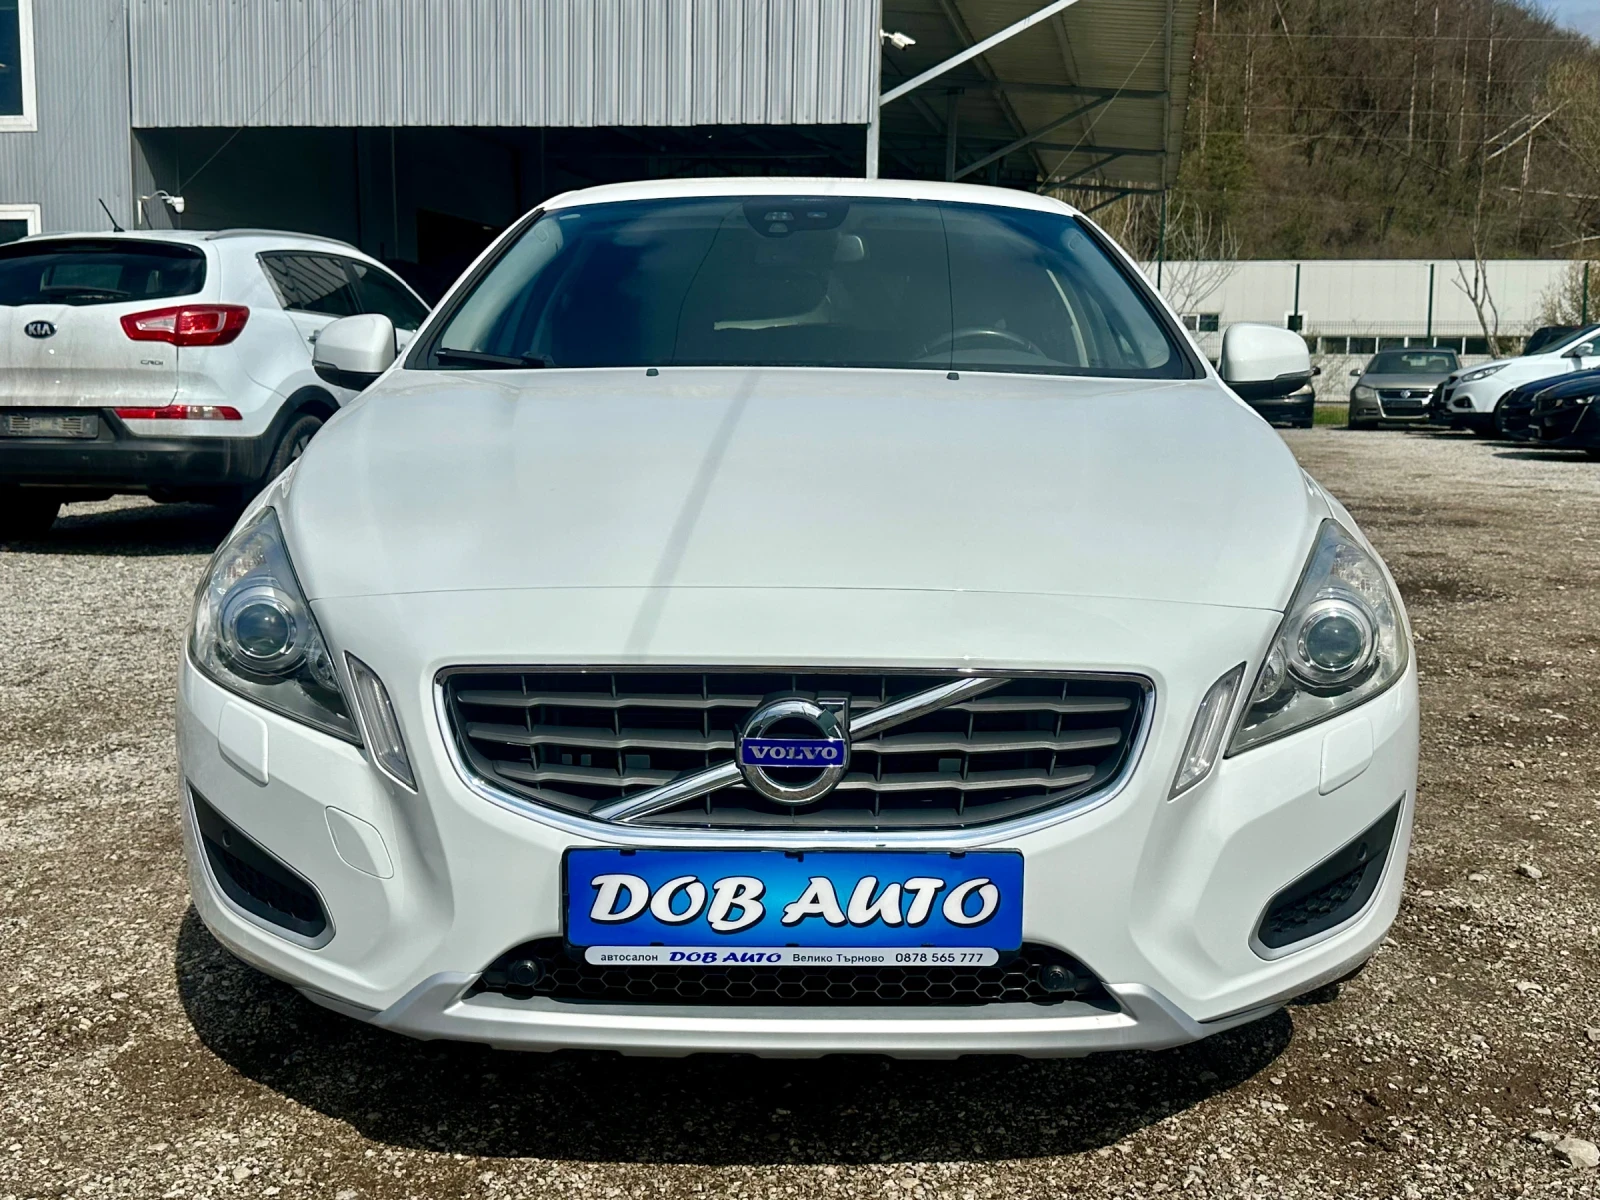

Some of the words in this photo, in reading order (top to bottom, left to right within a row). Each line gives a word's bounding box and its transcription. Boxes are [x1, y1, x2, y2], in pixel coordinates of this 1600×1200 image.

[28, 324, 51, 335] KIA
[748, 745, 838, 760] VOLVO
[589, 873, 766, 935] DOB
[781, 876, 1000, 929] AUTO
[600, 953, 658, 962] автосалон
[669, 951, 718, 964] DOB
[722, 952, 782, 963] AUTO
[792, 953, 833, 963] Велико
[836, 953, 885, 964] Търново
[895, 952, 928, 963] 0878
[931, 952, 955, 963] 565
[960, 952, 984, 963] 777
